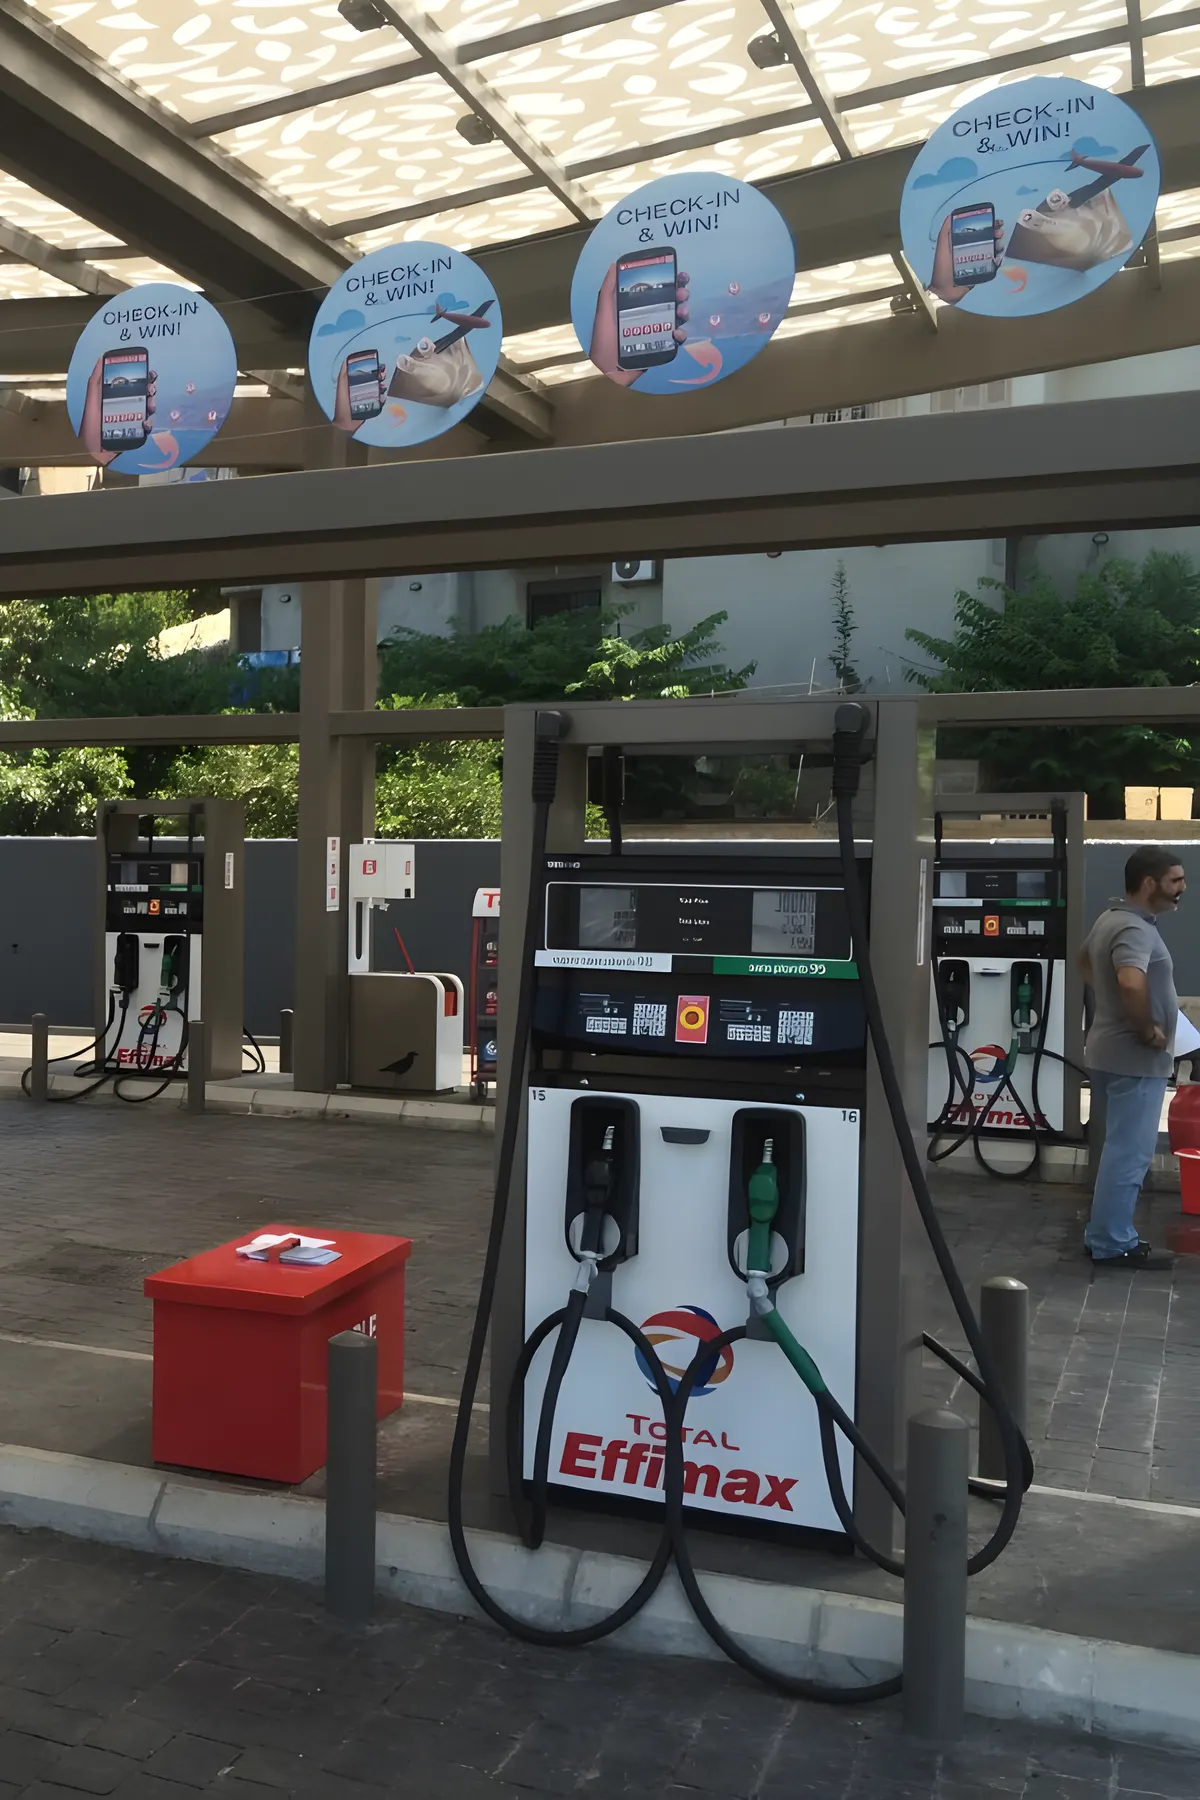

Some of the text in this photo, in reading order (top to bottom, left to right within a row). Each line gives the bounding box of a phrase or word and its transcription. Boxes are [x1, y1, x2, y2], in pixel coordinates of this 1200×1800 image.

[952, 96, 1095, 137] CHECK-IN
[977, 122, 1071, 153] & WIN!
[616, 188, 741, 226] CHECK-IN
[638, 213, 719, 242] & WIN!
[346, 256, 452, 293] CHECK-IN
[364, 279, 435, 306] & WIN!
[103, 301, 199, 325] CHECK-IN
[120, 327, 132, 342] &
[531, 1089, 546, 1102] 15
[841, 1109, 858, 1123] 16
[625, 1413, 740, 1451] TOTAL
[559, 1431, 799, 1512] Effimax
